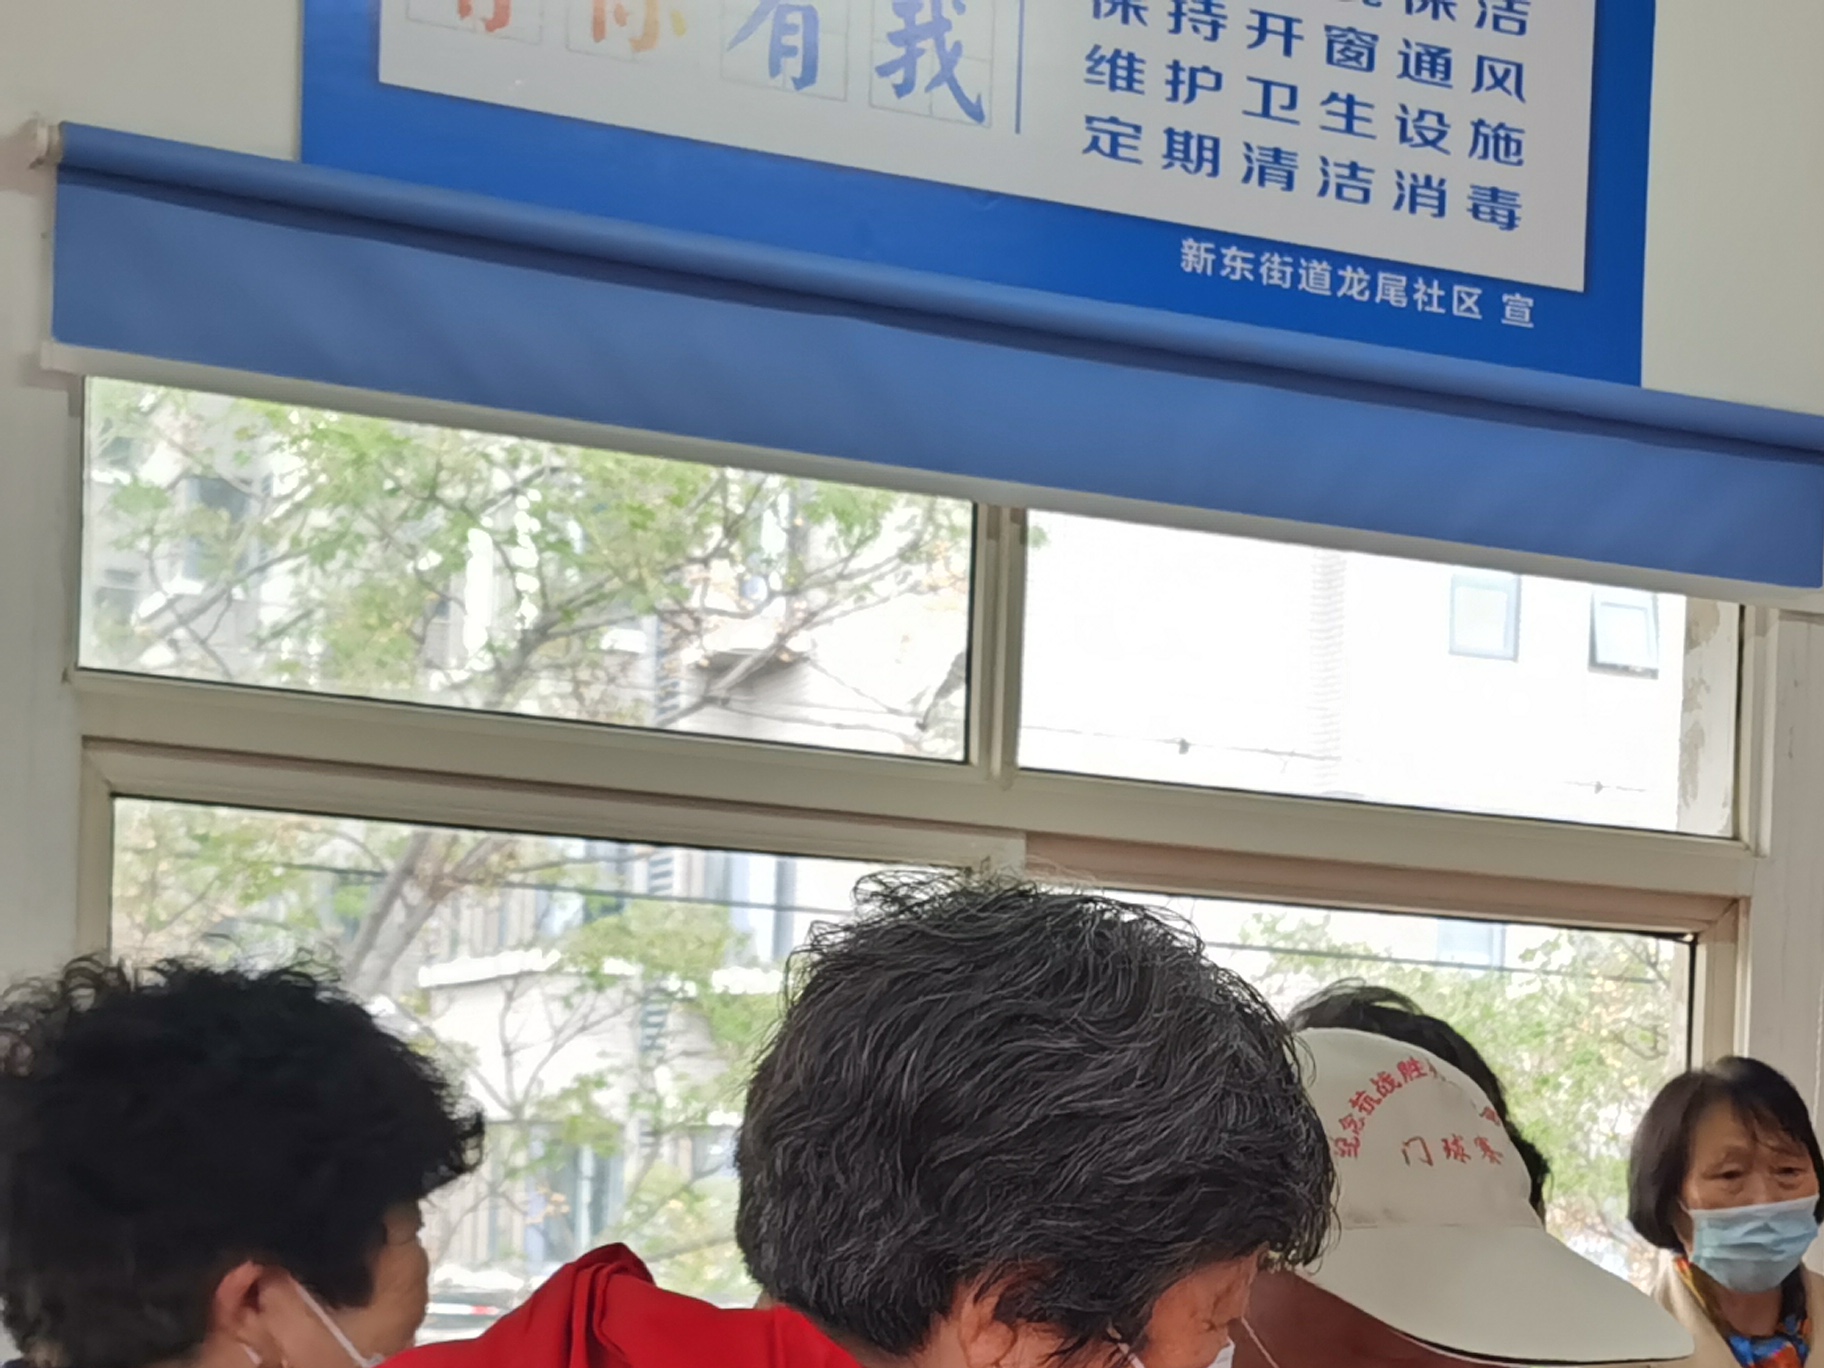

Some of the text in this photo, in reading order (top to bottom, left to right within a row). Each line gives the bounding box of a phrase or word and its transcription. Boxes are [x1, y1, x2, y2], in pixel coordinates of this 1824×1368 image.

[1083, 44, 1526, 168] 维护卫生设施
[1081, 114, 1523, 232] 定期清洁消毒
[1179, 237, 1535, 329] 新东街道龙尾社区 宣
